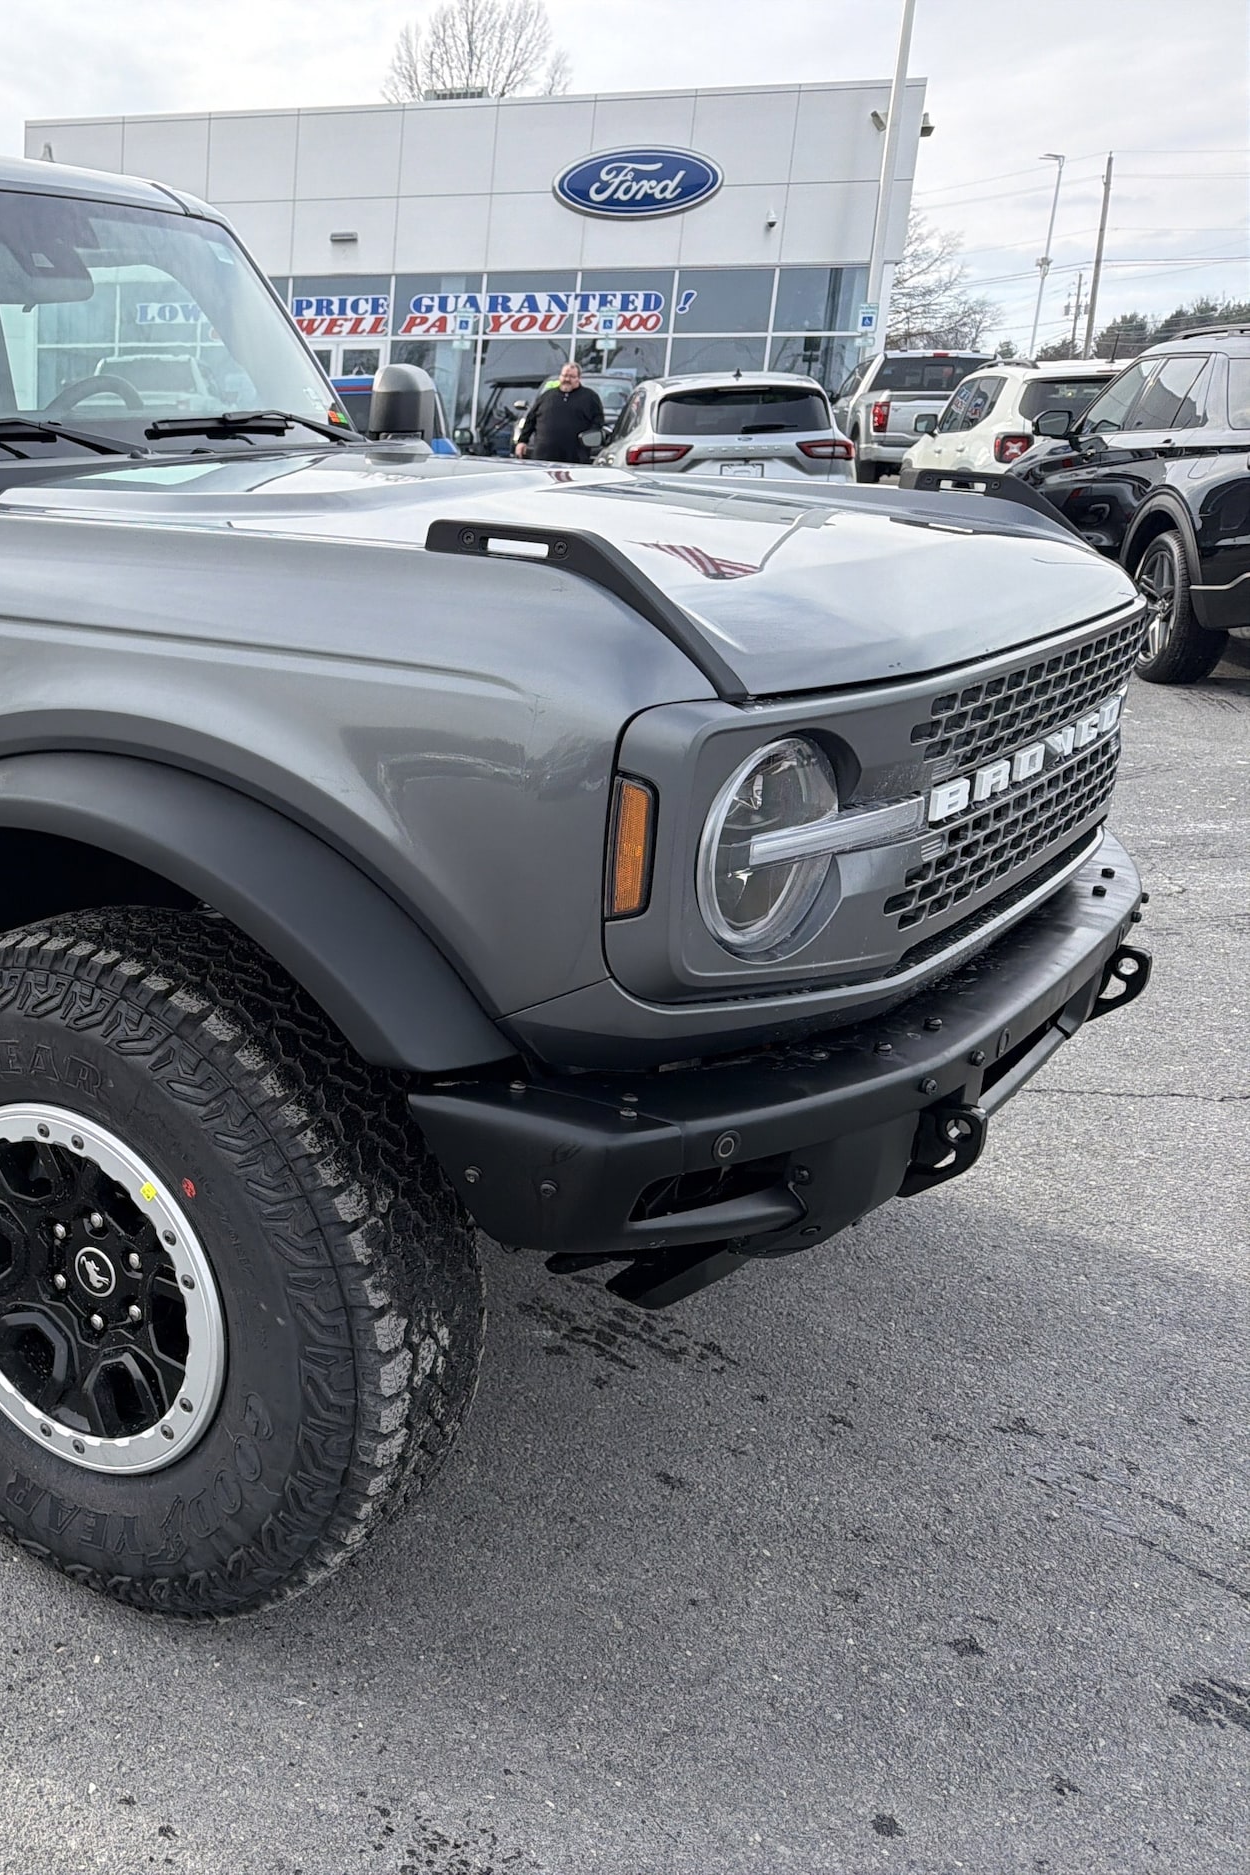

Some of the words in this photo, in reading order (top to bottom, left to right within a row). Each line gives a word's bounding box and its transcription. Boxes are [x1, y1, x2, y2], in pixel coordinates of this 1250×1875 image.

[589, 162, 677, 202] Ford
[294, 297, 388, 317] PRICE
[400, 314, 479, 334] PA
[486, 313, 567, 334] YOU
[928, 695, 1123, 822] BRONCO
